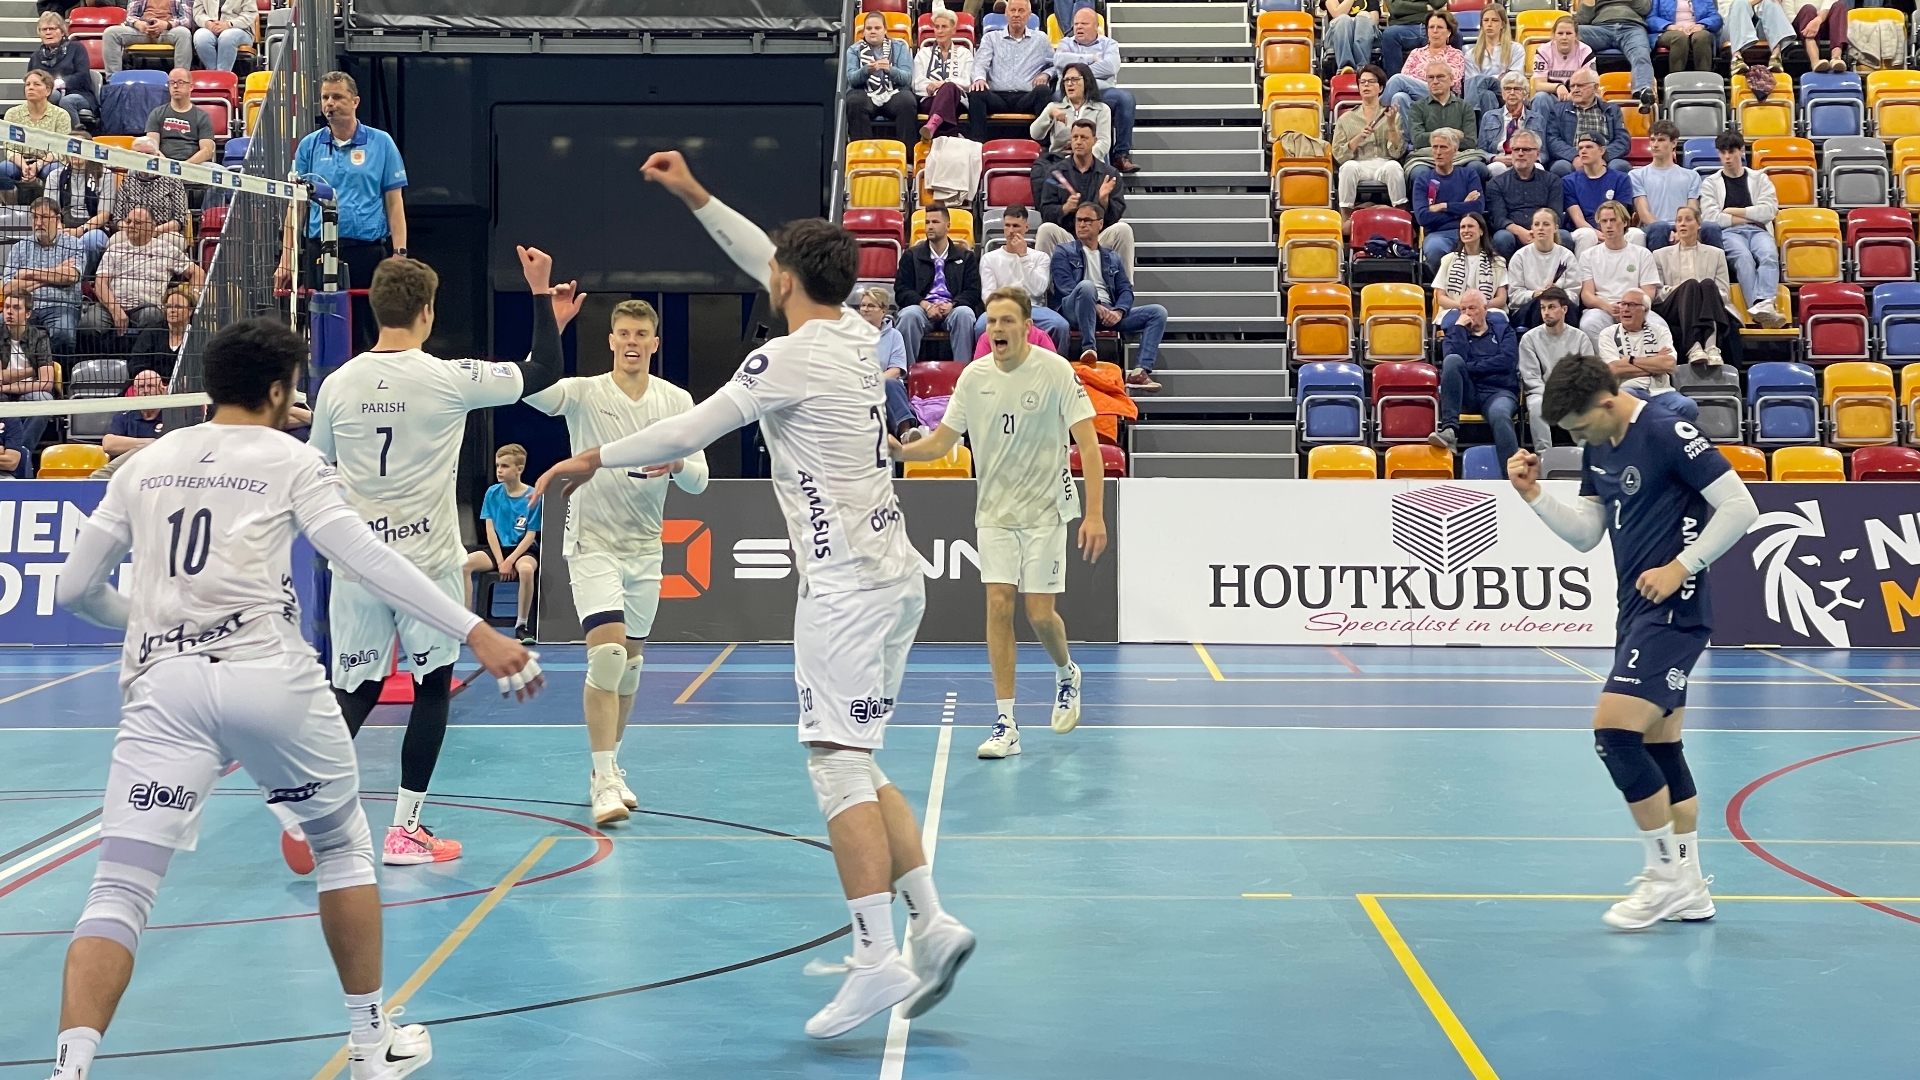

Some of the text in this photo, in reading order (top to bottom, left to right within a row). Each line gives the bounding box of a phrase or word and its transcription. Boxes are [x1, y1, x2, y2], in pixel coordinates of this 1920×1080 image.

[1534, 61, 1546, 71] 36
[361, 401, 406, 414] PARISH
[1002, 413, 1015, 435] 21
[376, 426, 393, 477] 7
[139, 473, 269, 495] POZO HERNÁNDEZ
[797, 469, 832, 560] AMASUS
[167, 506, 213, 578] 10
[384, 517, 431, 544] next
[1864, 513, 1920, 570] N
[1209, 564, 1593, 611] HOUTKUBUS
[177, 612, 245, 653] next
[1304, 612, 1594, 637] Specialist in vloeren
[1627, 648, 1640, 669] 2
[801, 687, 813, 713] 20
